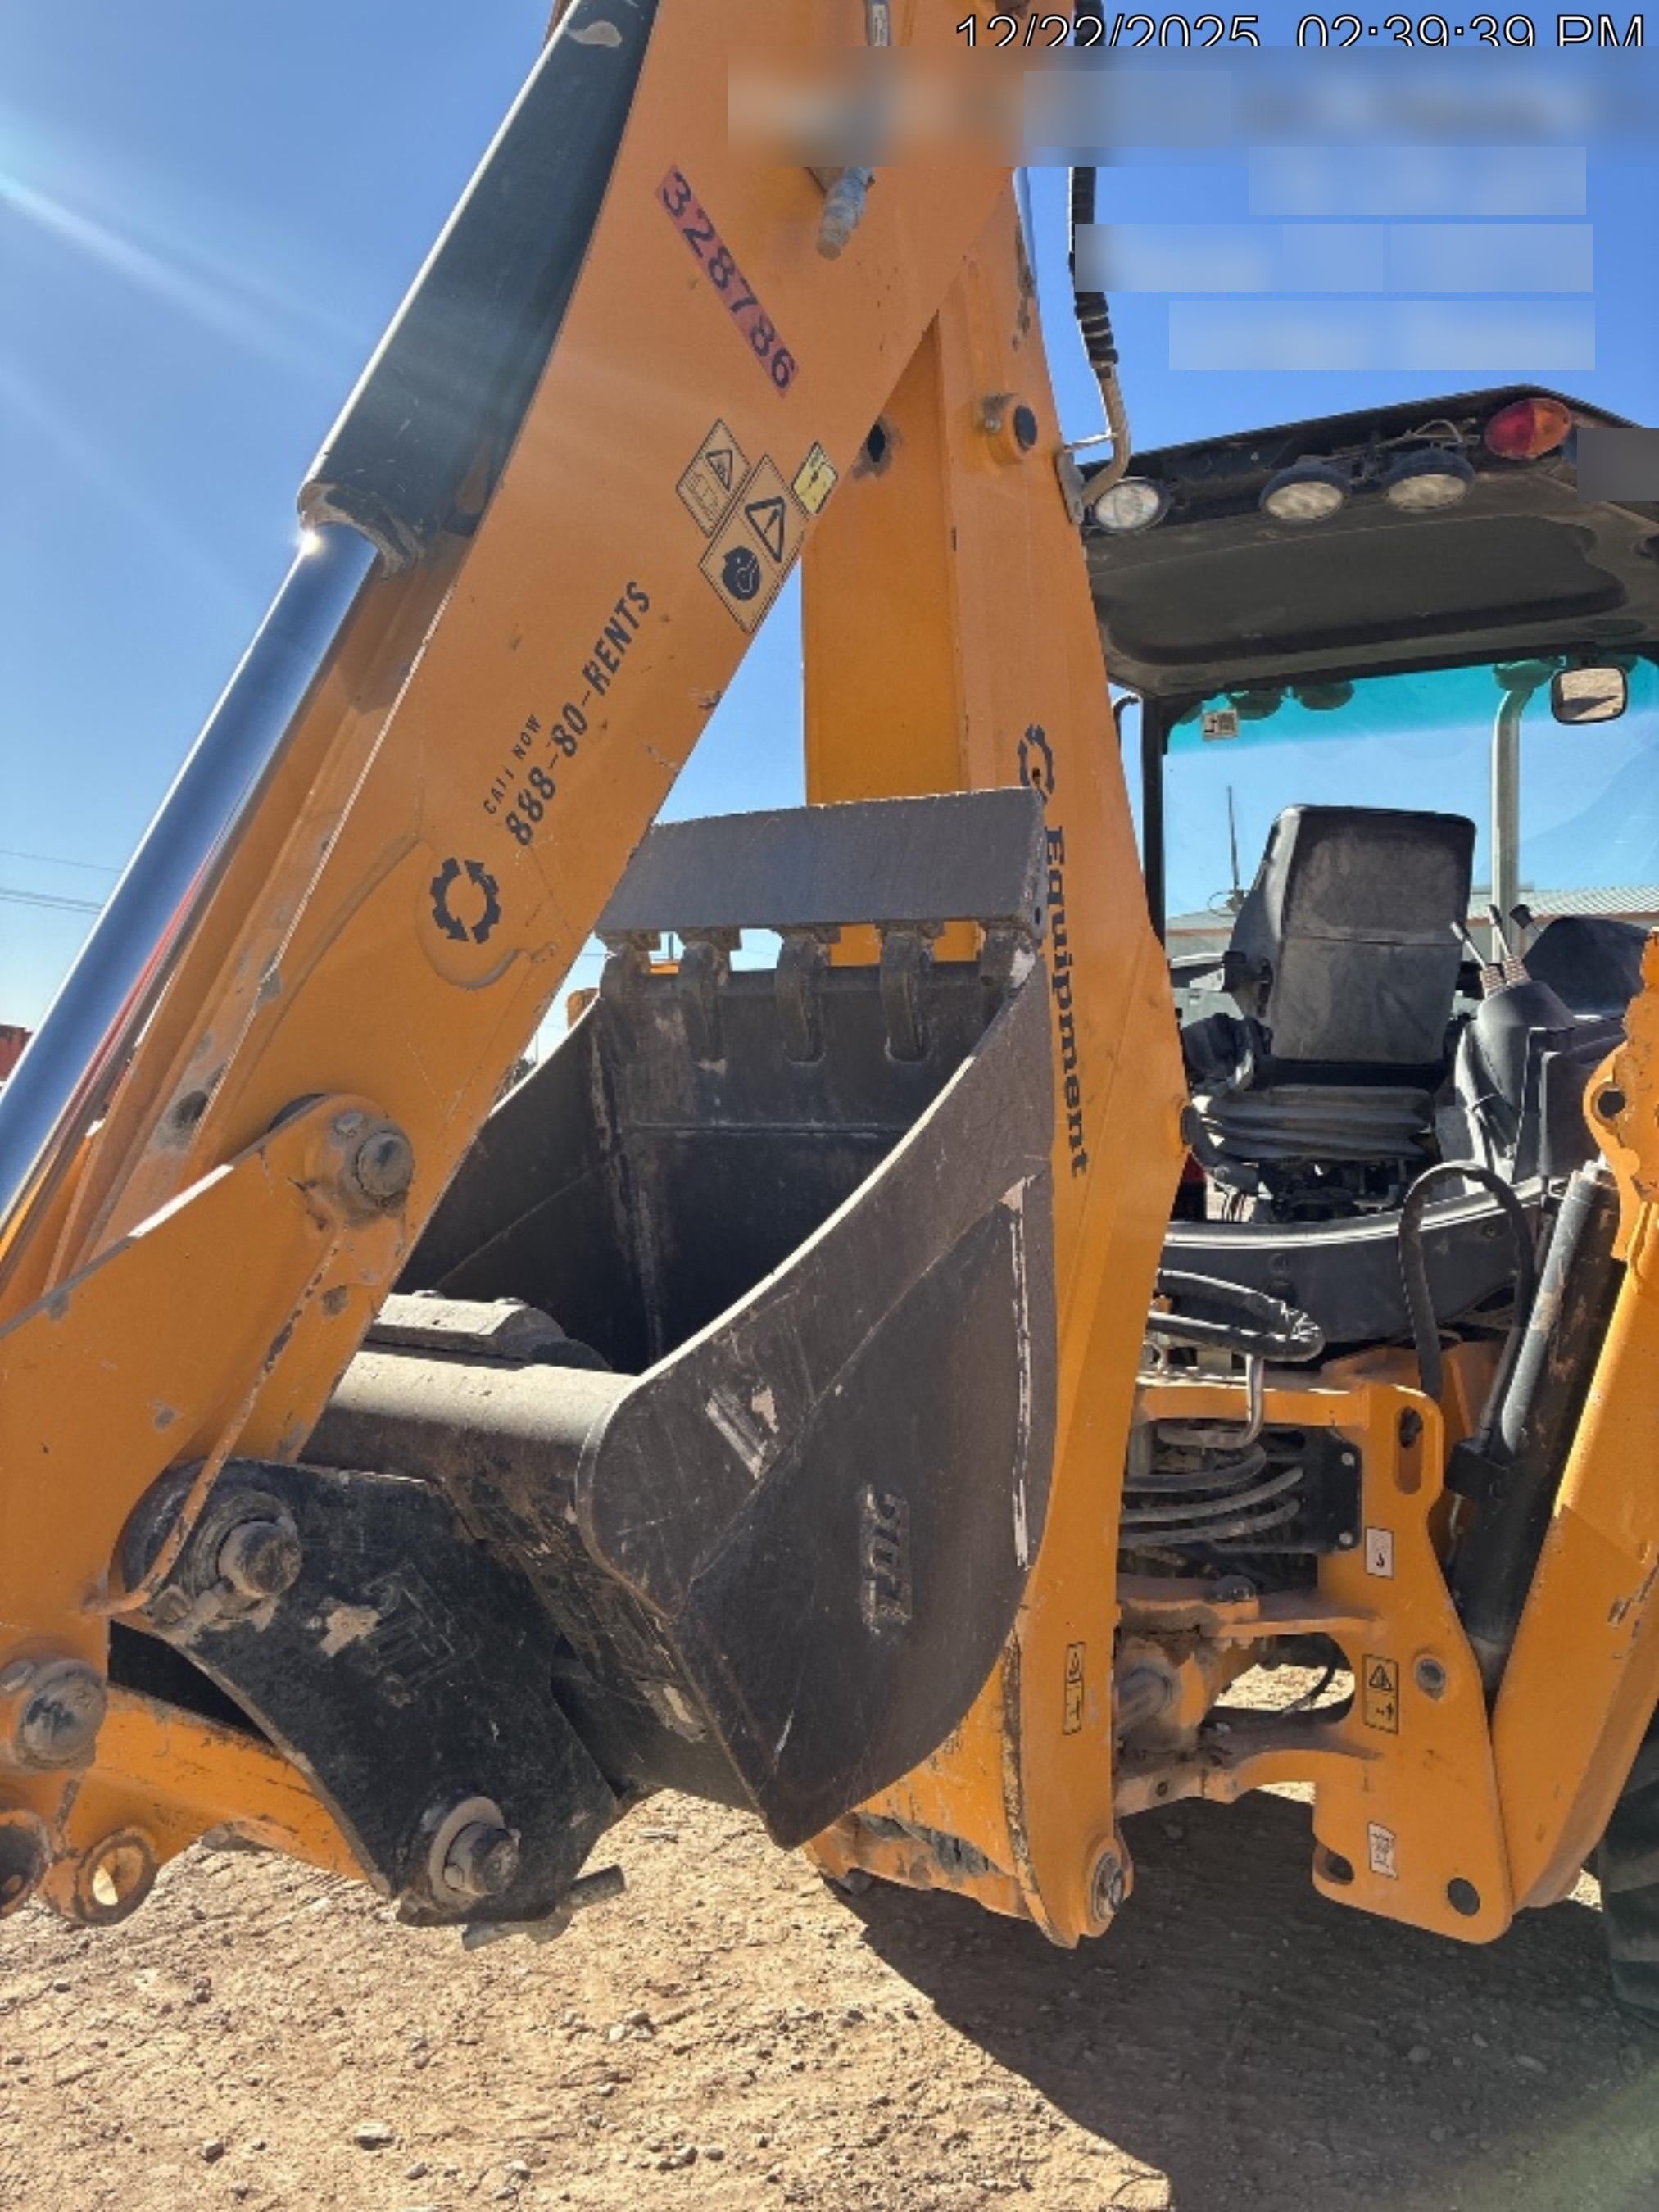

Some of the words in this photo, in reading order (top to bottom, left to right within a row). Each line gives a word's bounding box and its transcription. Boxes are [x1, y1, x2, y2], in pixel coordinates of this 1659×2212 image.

[662, 171, 795, 388] 328786
[505, 581, 650, 846] 888-80-RENTS
[512, 714, 542, 760] NOW
[1044, 825, 1089, 1178] Equipment
